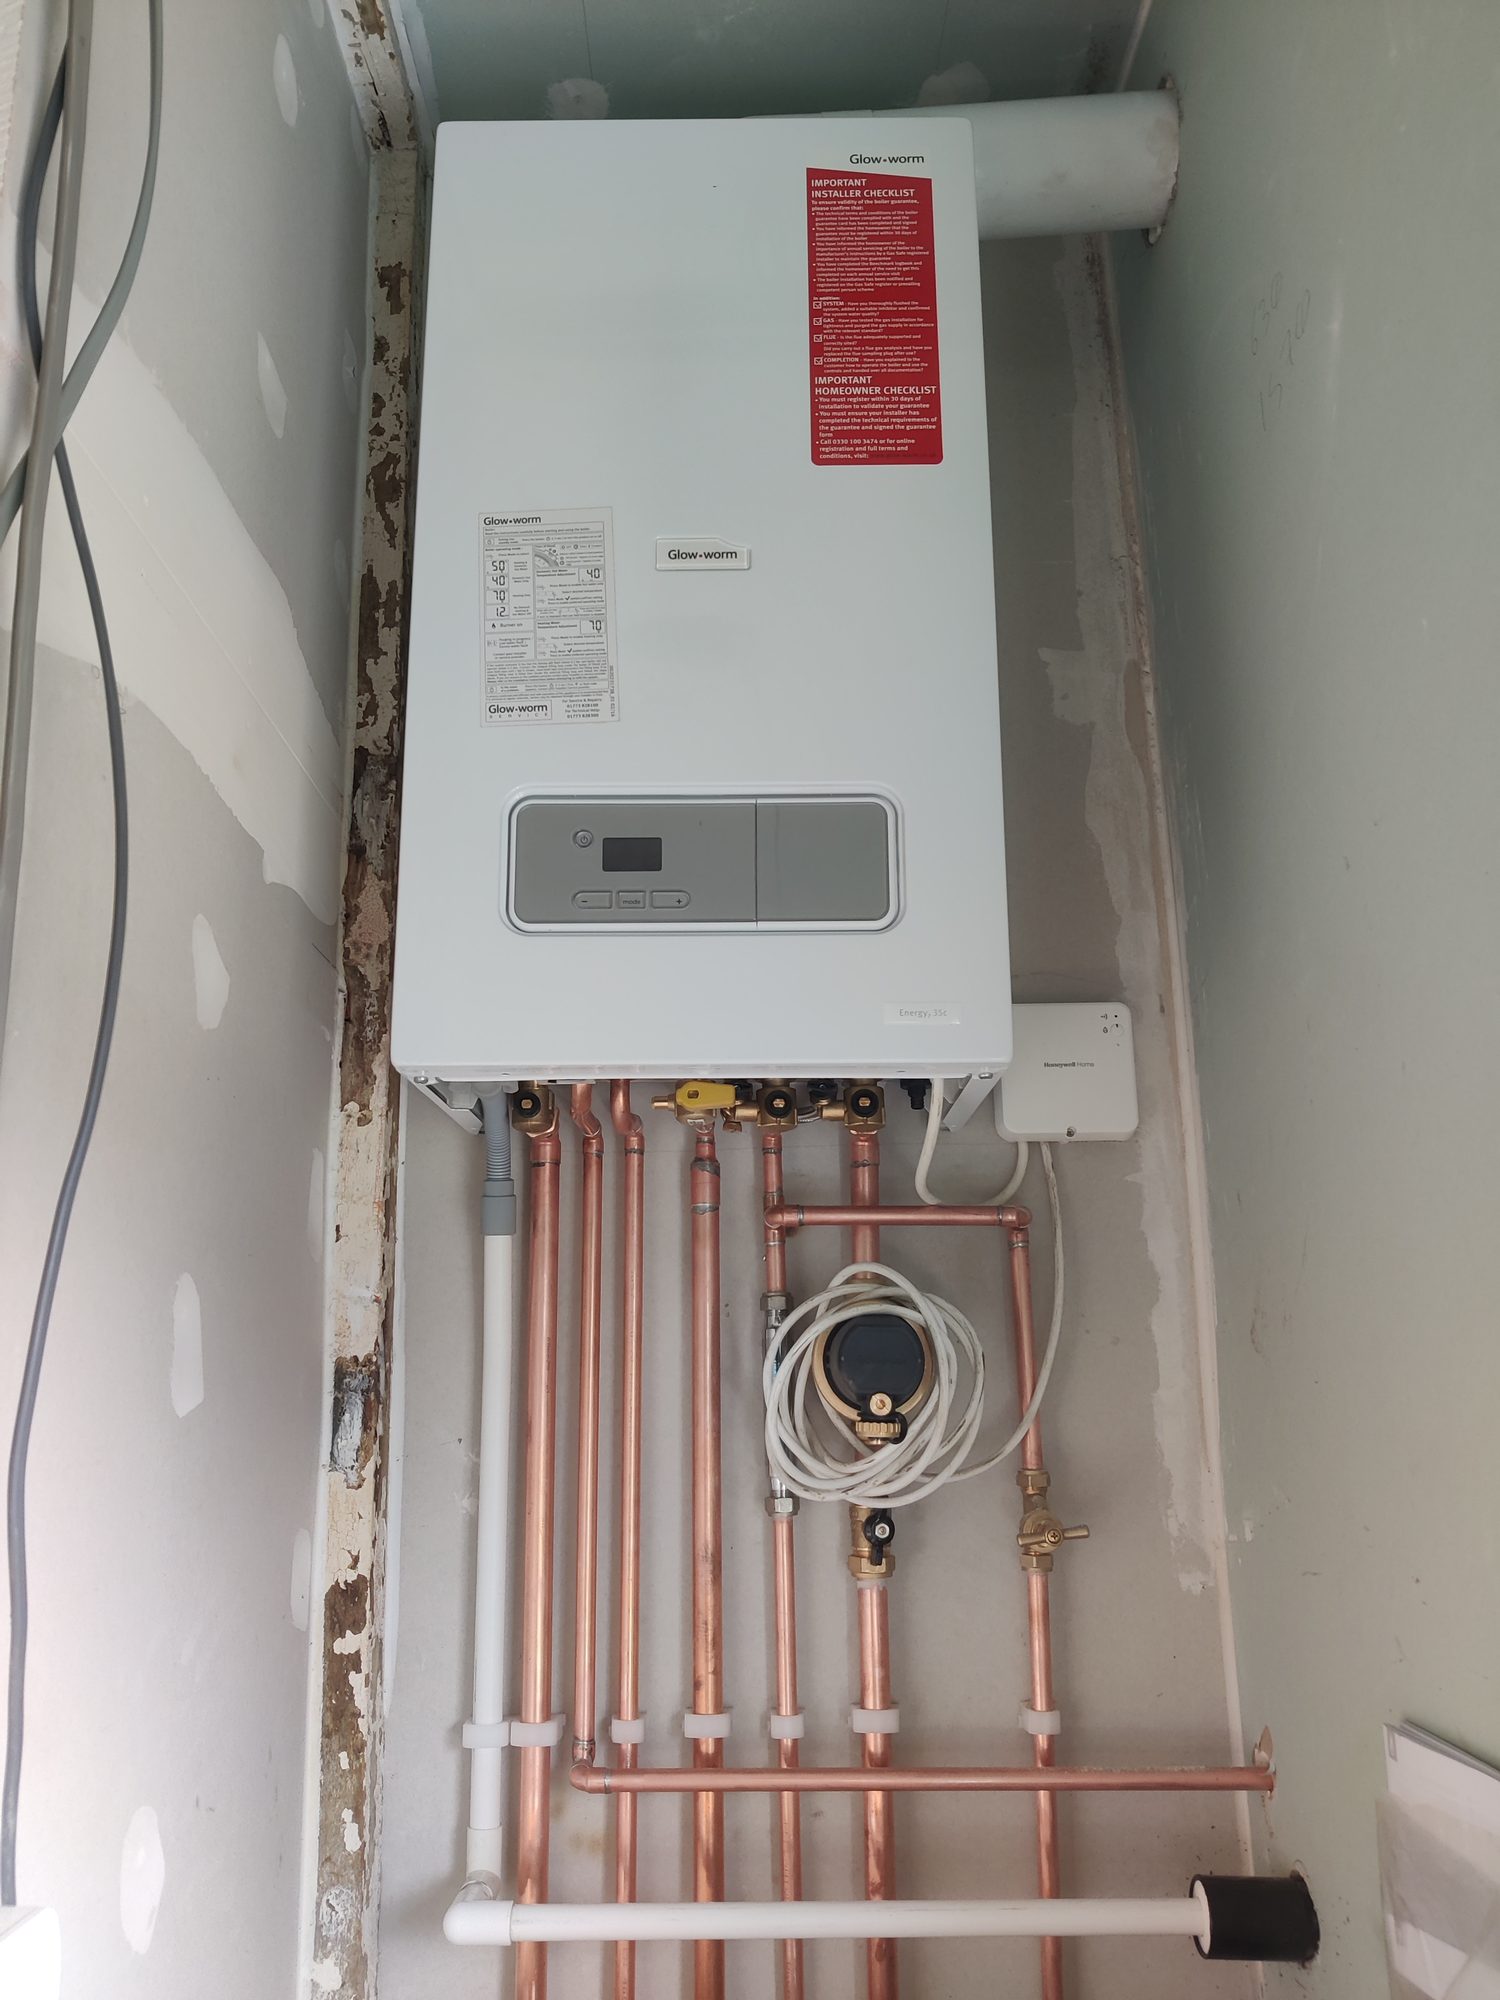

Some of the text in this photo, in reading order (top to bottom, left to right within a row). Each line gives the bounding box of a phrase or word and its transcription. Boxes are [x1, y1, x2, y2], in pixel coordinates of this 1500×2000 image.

[812, 179, 867, 187] IMPORTANT
[812, 189, 915, 198] INSTALLER CHECKLIST
[816, 377, 872, 385] IMPORTANT
[816, 386, 936, 395] HOMEOWNER CHECKLIST
[492, 560, 505, 572] 50
[587, 568, 600, 579] 40
[492, 575, 505, 586] 40
[493, 590, 505, 601] 70
[497, 607, 506, 617] 12
[589, 620, 602, 631] 70
[900, 1009, 931, 1018] Energy,
